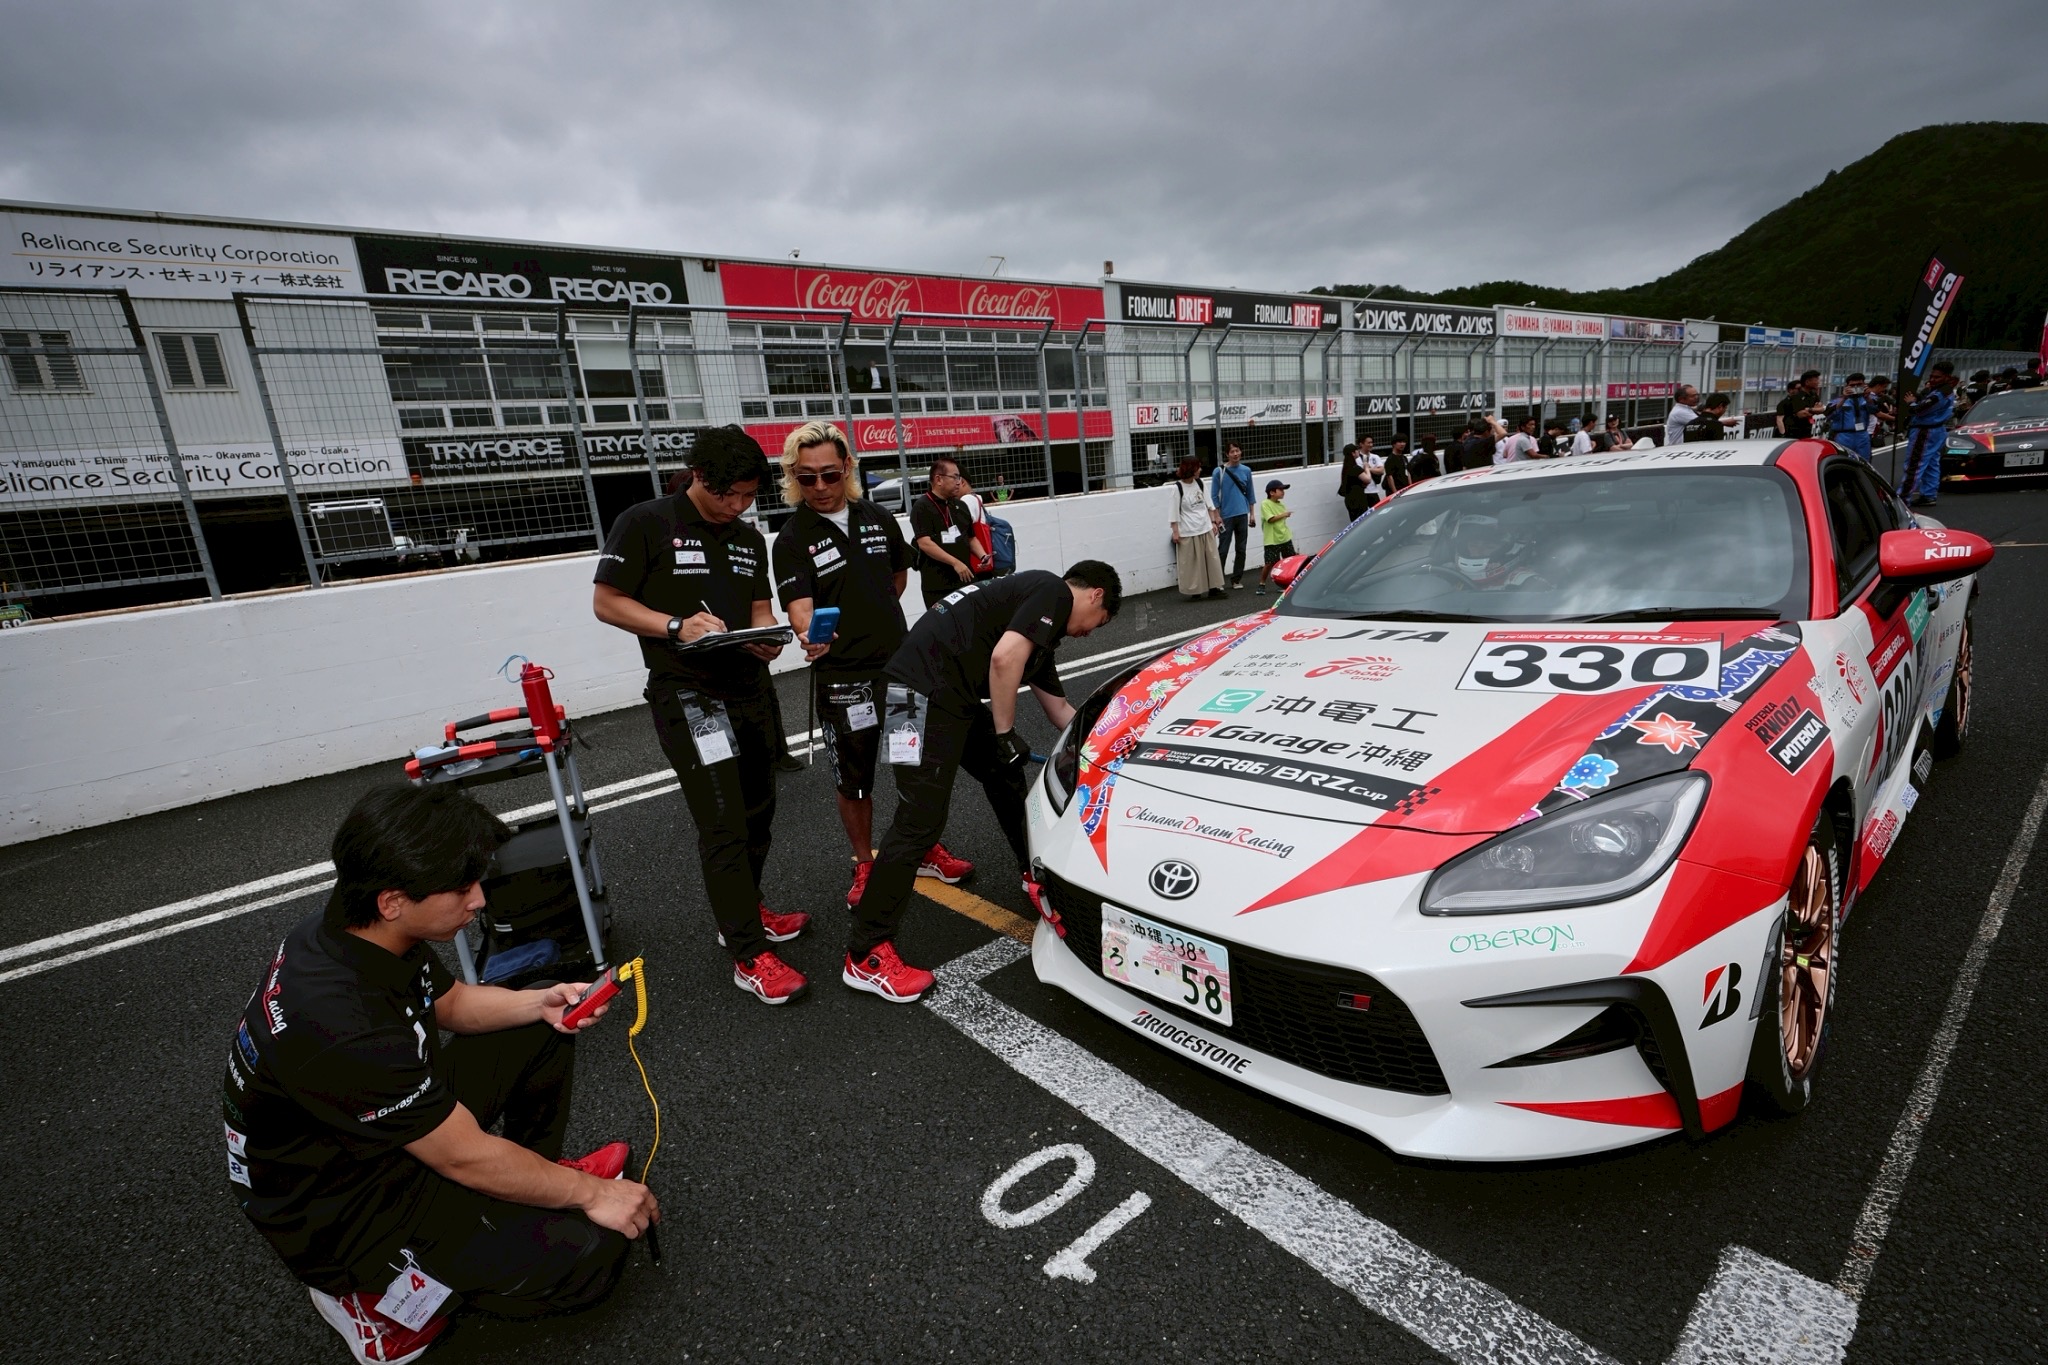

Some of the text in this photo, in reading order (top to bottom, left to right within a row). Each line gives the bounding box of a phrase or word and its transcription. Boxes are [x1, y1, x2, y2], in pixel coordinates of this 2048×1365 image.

[21, 231, 340, 265] Reliance Security Corporation
[436, 255, 478, 264] SINCE 1906
[29, 261, 344, 290] リライアンス・セキュリティー株式会社
[591, 264, 627, 273] SINCE 1906
[384, 267, 532, 298] RECARO
[549, 276, 672, 304] RECARO
[806, 273, 913, 318] Coca-Cola
[1128, 296, 1232, 322] FORMULA DRIFT JAPAN
[1254, 304, 1338, 327] FORMULA DRIFT JAPAN
[1514, 316, 1539, 331] YAMAHA
[1549, 318, 1572, 333] YAMAHA
[1581, 321, 1603, 335] YAMAHA
[1904, 273, 1957, 370] tomica
[583, 433, 695, 453] TRYFORCE
[863, 423, 915, 445] Coca-Cla
[925, 428, 943, 436] TASTE
[12, 447, 349, 469] Yamaguchi Ehime Hiroima Okayama yogo Osaka
[425, 438, 564, 460] TRYFORCE
[430, 462, 463, 470] Racing
[684, 539, 702, 547] JTA
[817, 537, 832, 550] JTA
[1326, 629, 1449, 643] JTA
[1474, 643, 1709, 692] 330
[866, 705, 873, 715] 3
[1255, 695, 1438, 734] 沖電工
[1744, 702, 1778, 732] POTENZA
[1755, 695, 1801, 745] RW007
[908, 737, 916, 748] 4
[1158, 724, 1433, 772] GR Garage 沖縄
[1779, 718, 1823, 765] POTENZA
[1130, 919, 1197, 962] 沖縄 338
[1450, 924, 1575, 953] OBERON
[1109, 946, 1124, 967] ろ
[1130, 1009, 1252, 1075] BRIDGESTONE
[378, 1091, 420, 1118] Garage
[410, 1273, 426, 1293] 4
